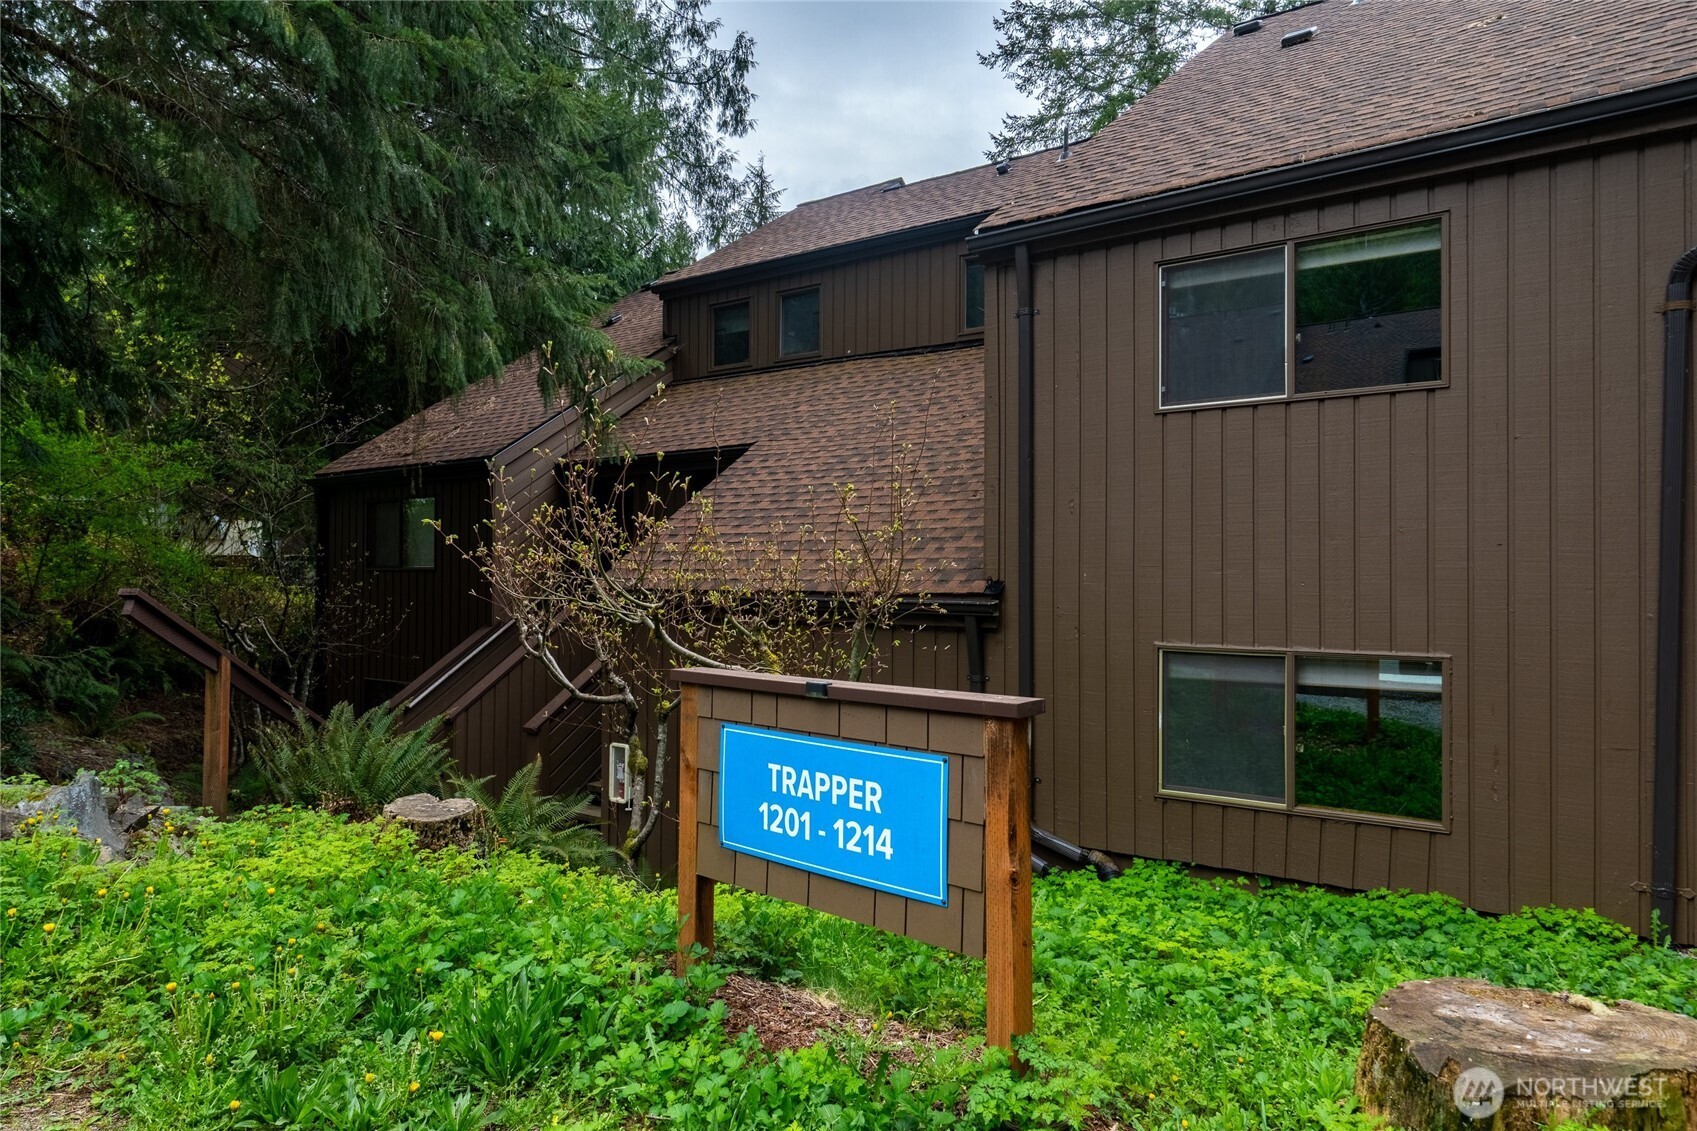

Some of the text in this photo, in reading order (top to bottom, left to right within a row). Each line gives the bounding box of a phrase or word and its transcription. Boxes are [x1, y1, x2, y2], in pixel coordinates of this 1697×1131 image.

[768, 763, 882, 814] TRAPPER
[758, 802, 894, 860] 1201 - 1214
